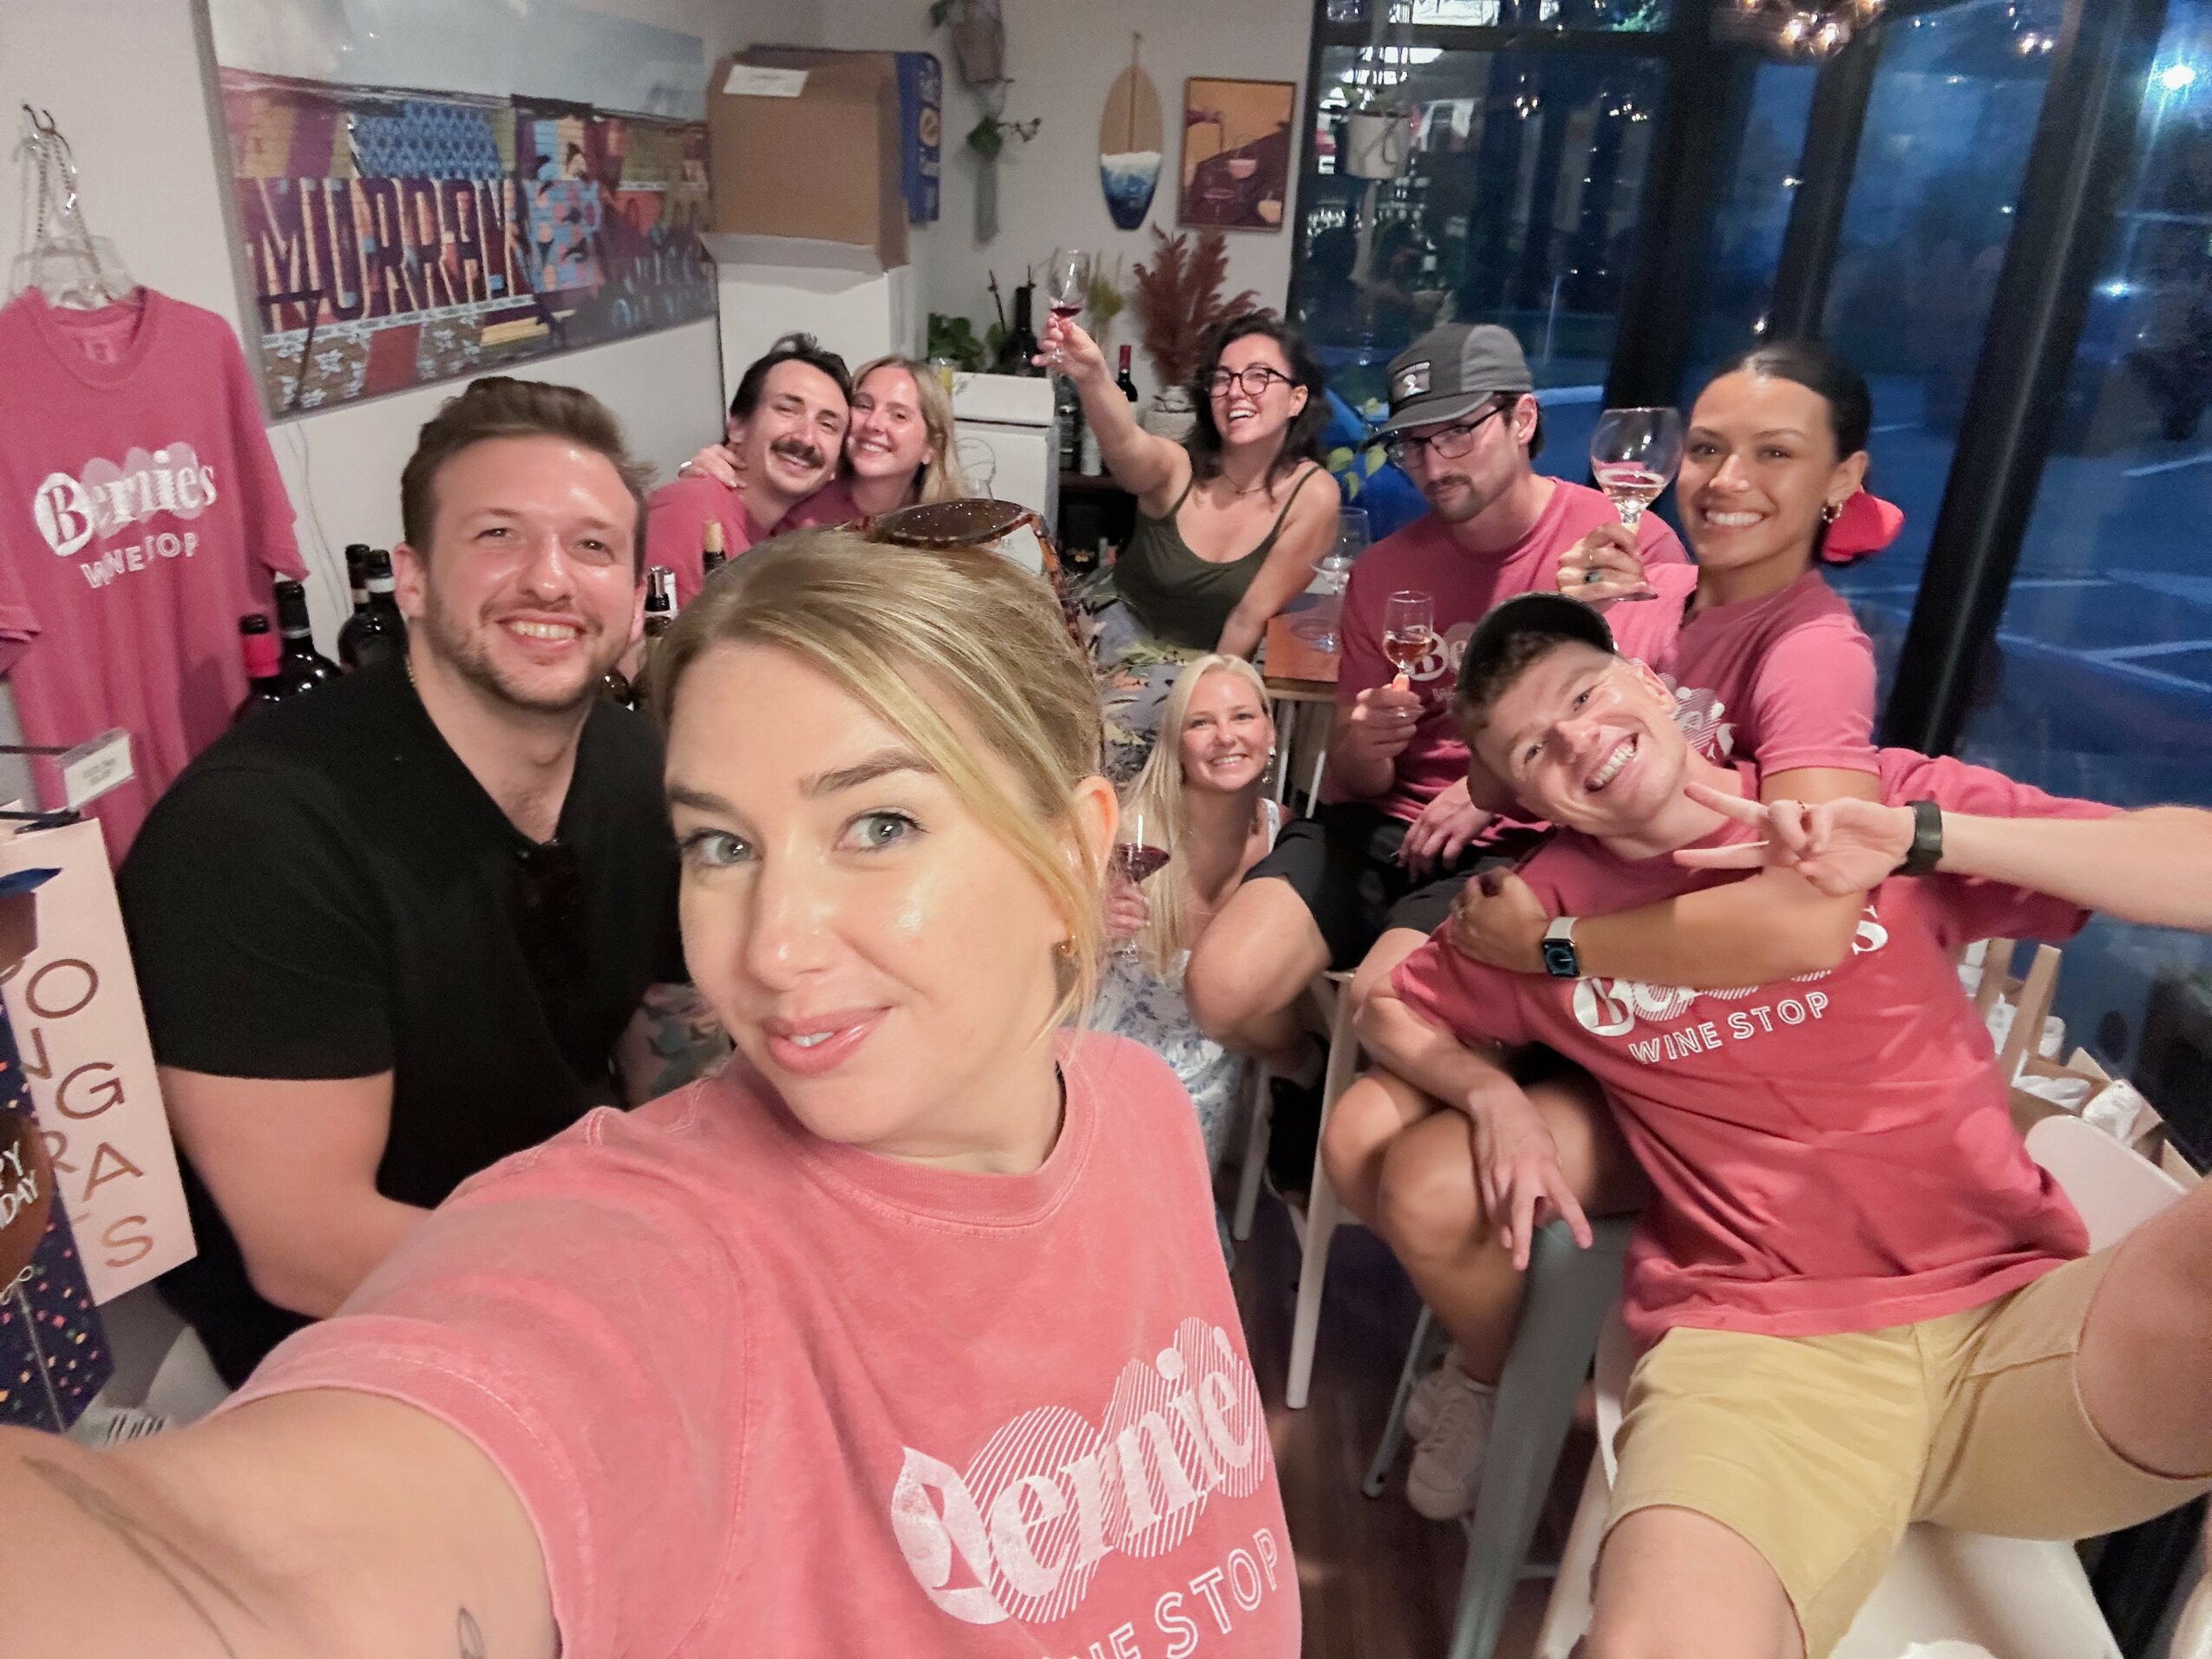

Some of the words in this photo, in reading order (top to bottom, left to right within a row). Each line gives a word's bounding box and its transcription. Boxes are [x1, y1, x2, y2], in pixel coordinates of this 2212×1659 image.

[1628, 1021, 1723, 1065] WINE
[1727, 991, 1829, 1040] STOP
[1155, 1528, 1278, 1659] STOP
